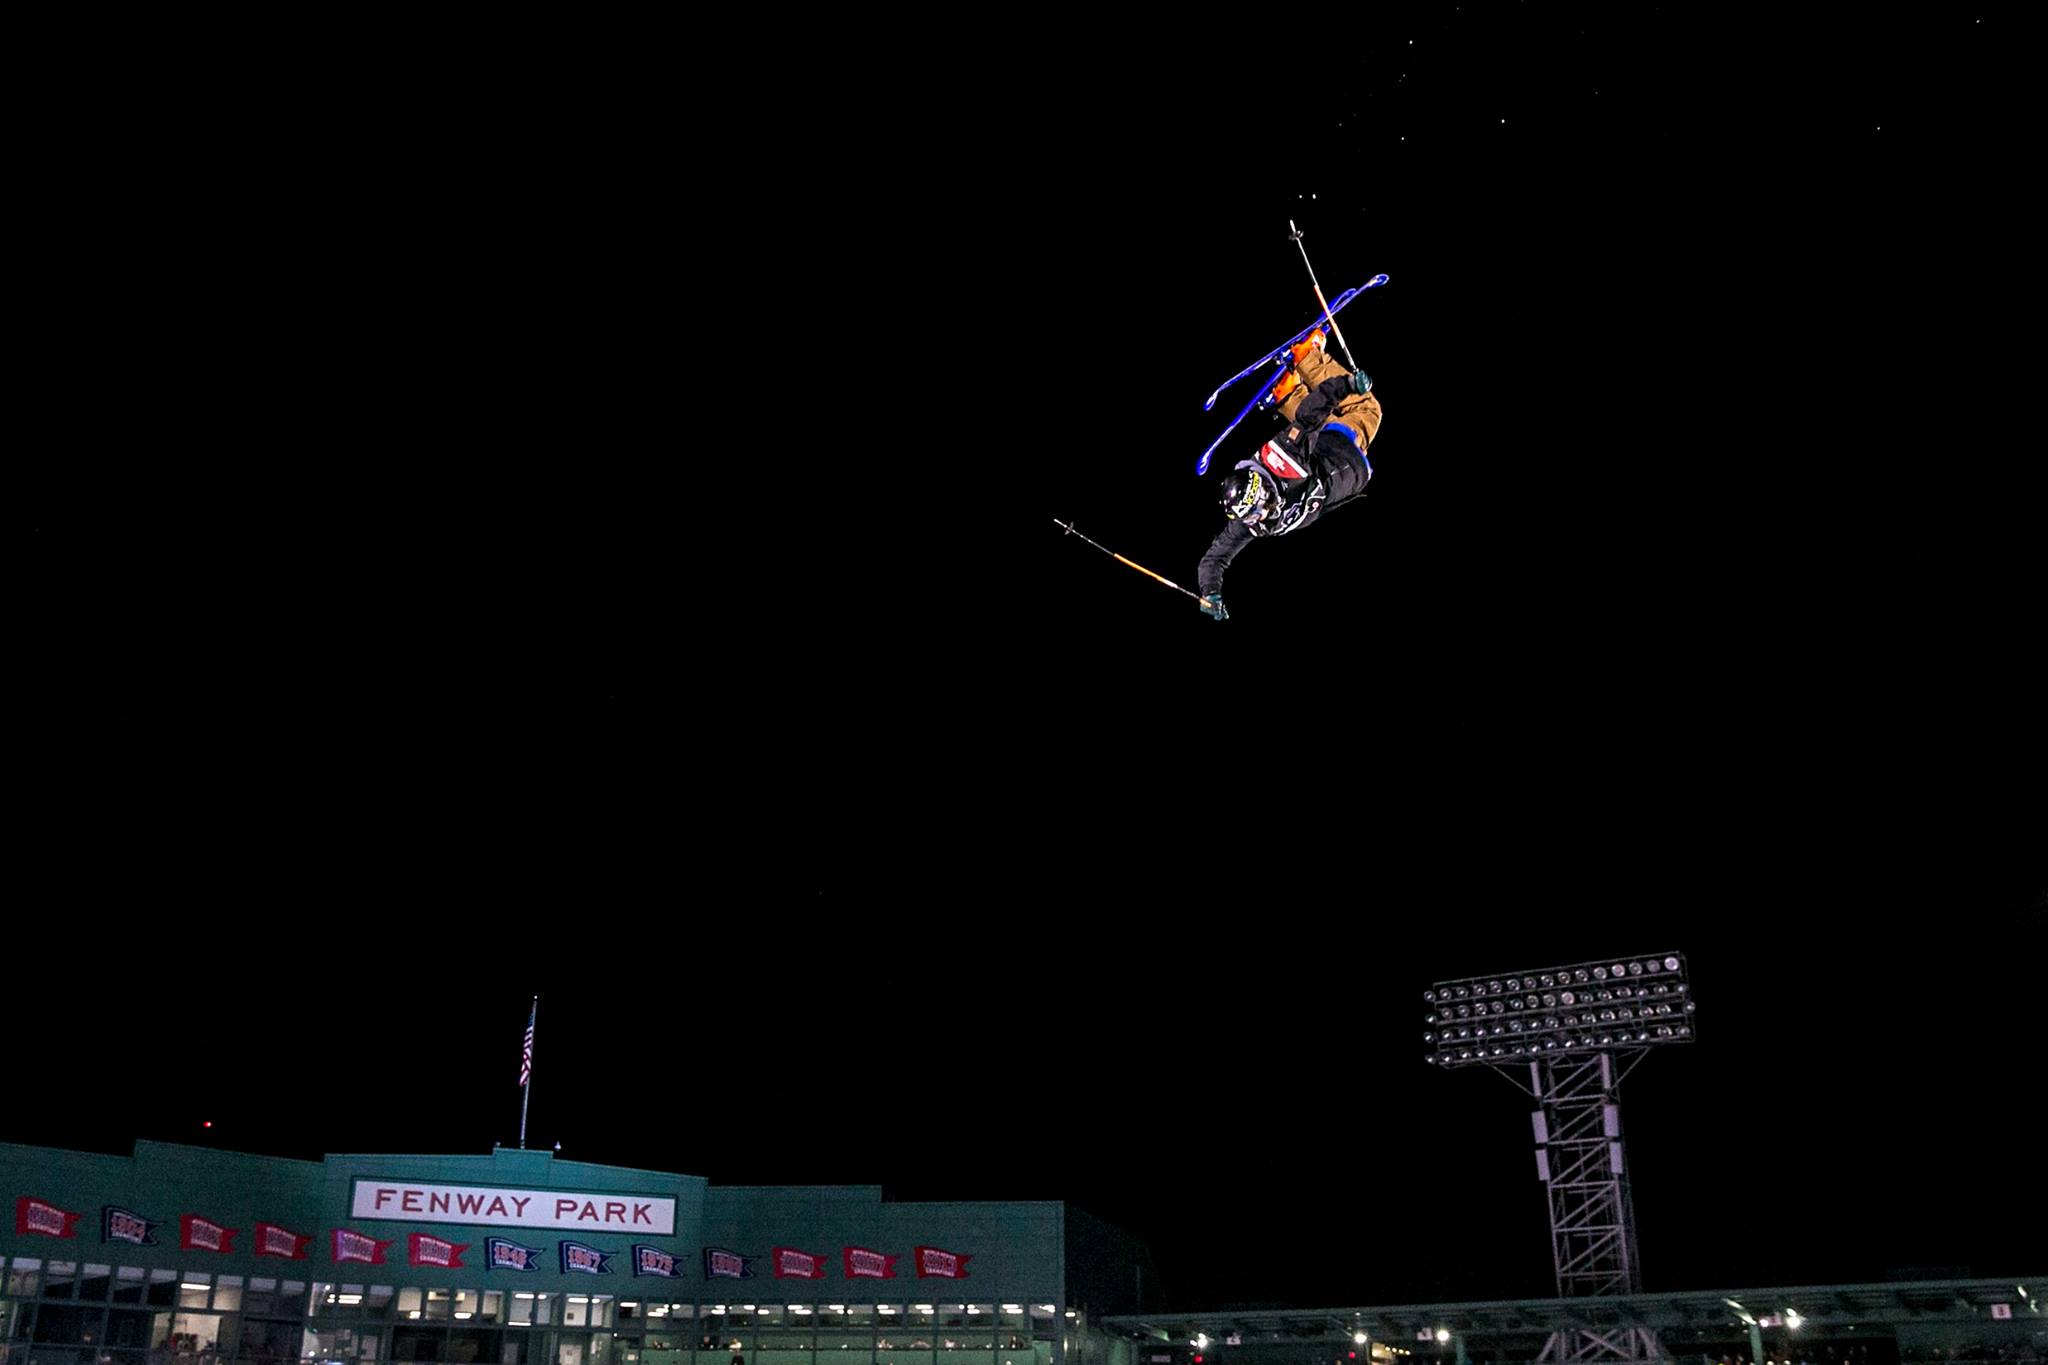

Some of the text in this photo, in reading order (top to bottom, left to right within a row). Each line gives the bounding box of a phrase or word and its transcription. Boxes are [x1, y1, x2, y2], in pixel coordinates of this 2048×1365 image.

[375, 1189, 652, 1225] FENWAY PARK
[568, 1249, 601, 1268] 1967
[641, 1253, 674, 1273] 1975
